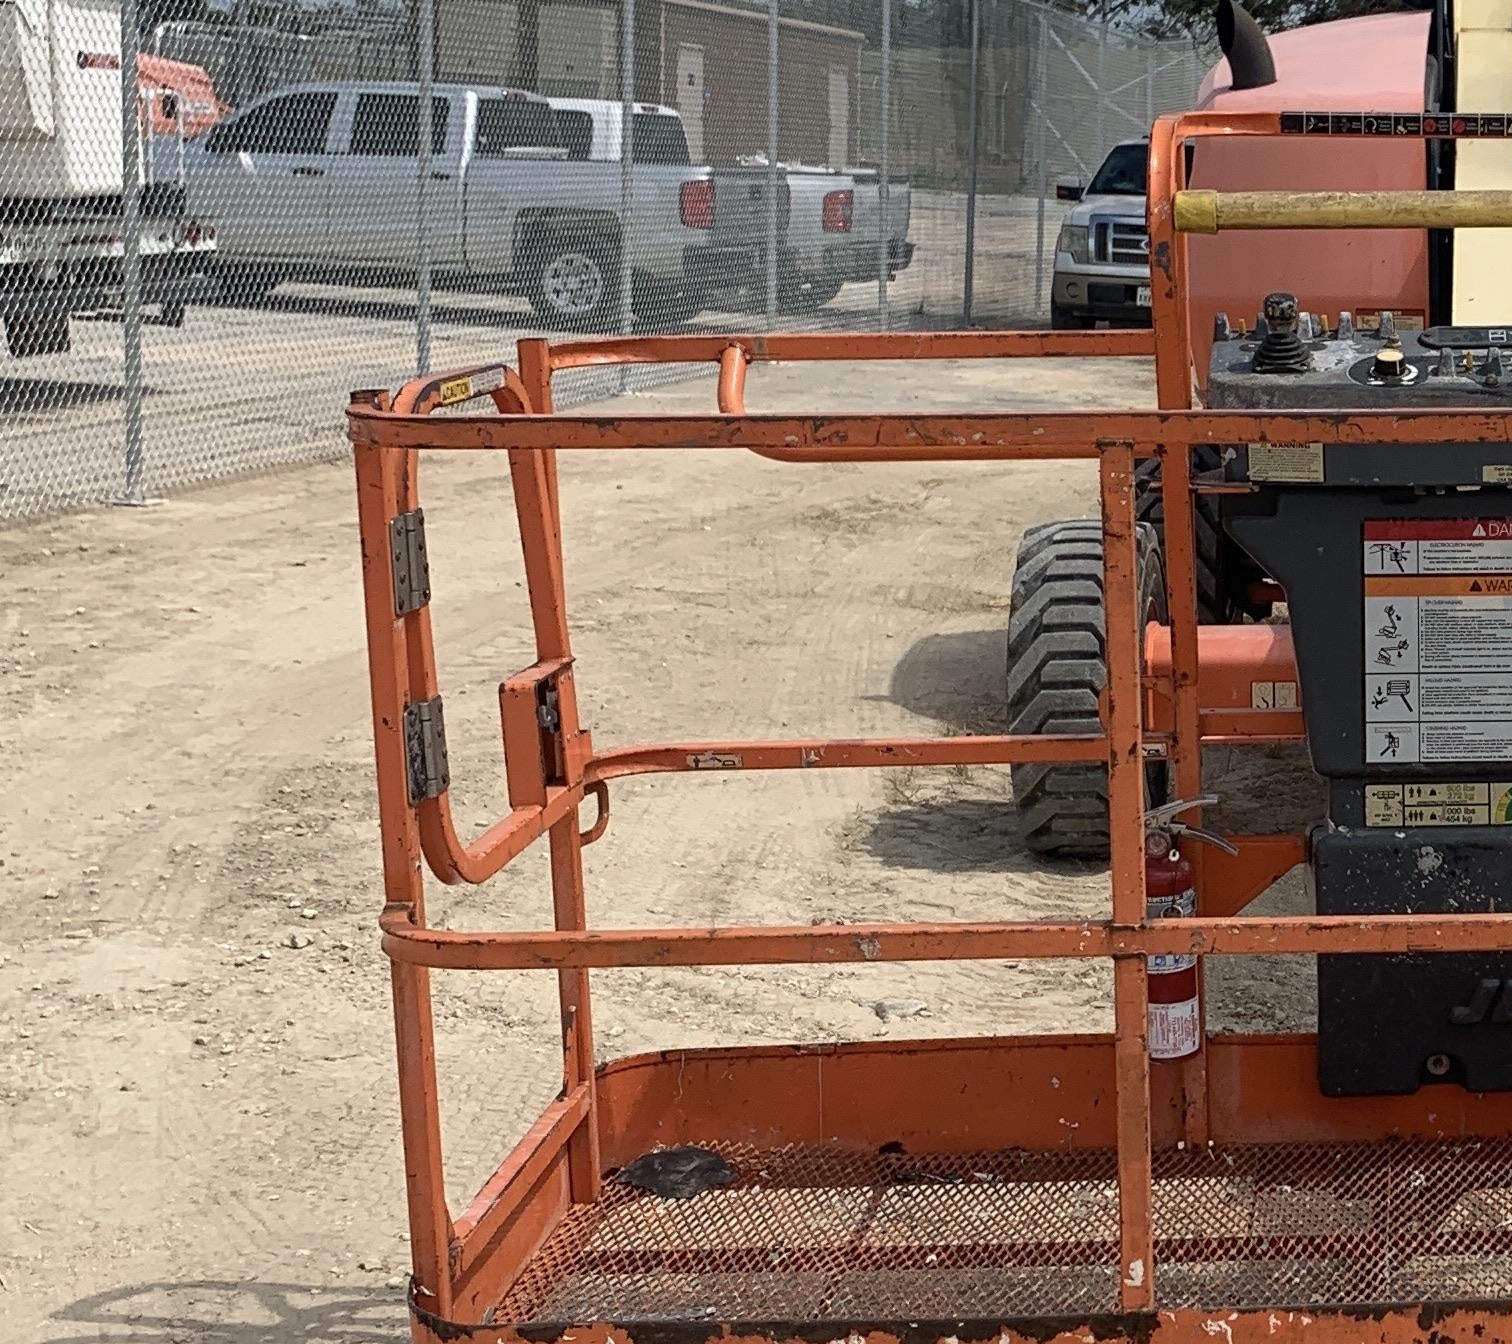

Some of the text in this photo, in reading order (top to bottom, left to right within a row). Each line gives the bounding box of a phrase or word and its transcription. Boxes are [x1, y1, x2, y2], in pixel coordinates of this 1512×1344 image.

[1463, 807, 1476, 815] lbs
[1445, 814, 1472, 823] 454 kg
